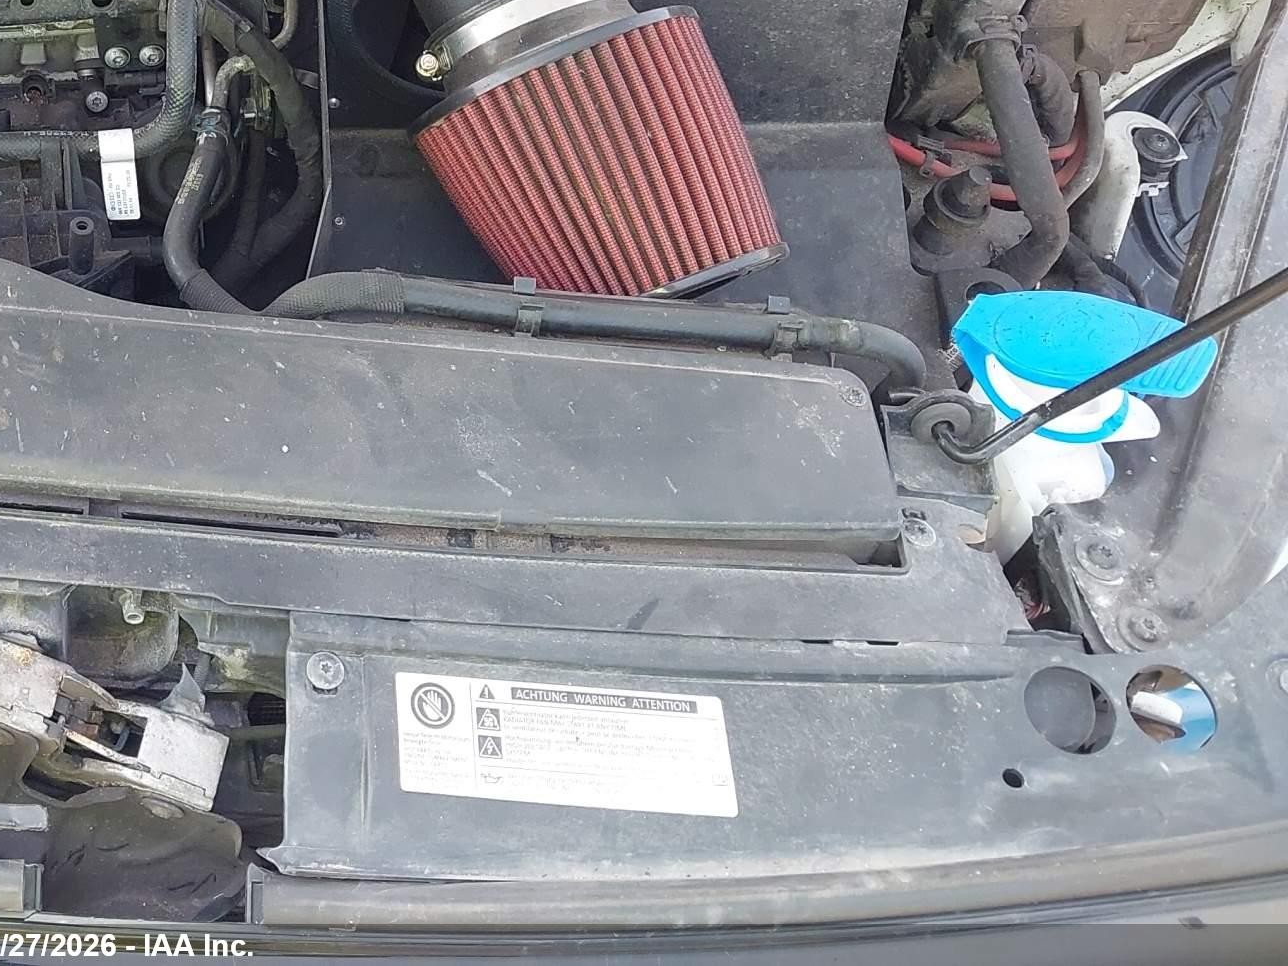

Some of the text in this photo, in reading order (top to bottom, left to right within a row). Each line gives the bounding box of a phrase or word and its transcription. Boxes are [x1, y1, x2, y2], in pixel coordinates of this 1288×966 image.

[515, 689, 691, 712] ACHTUNG WARNING ATTENTION
